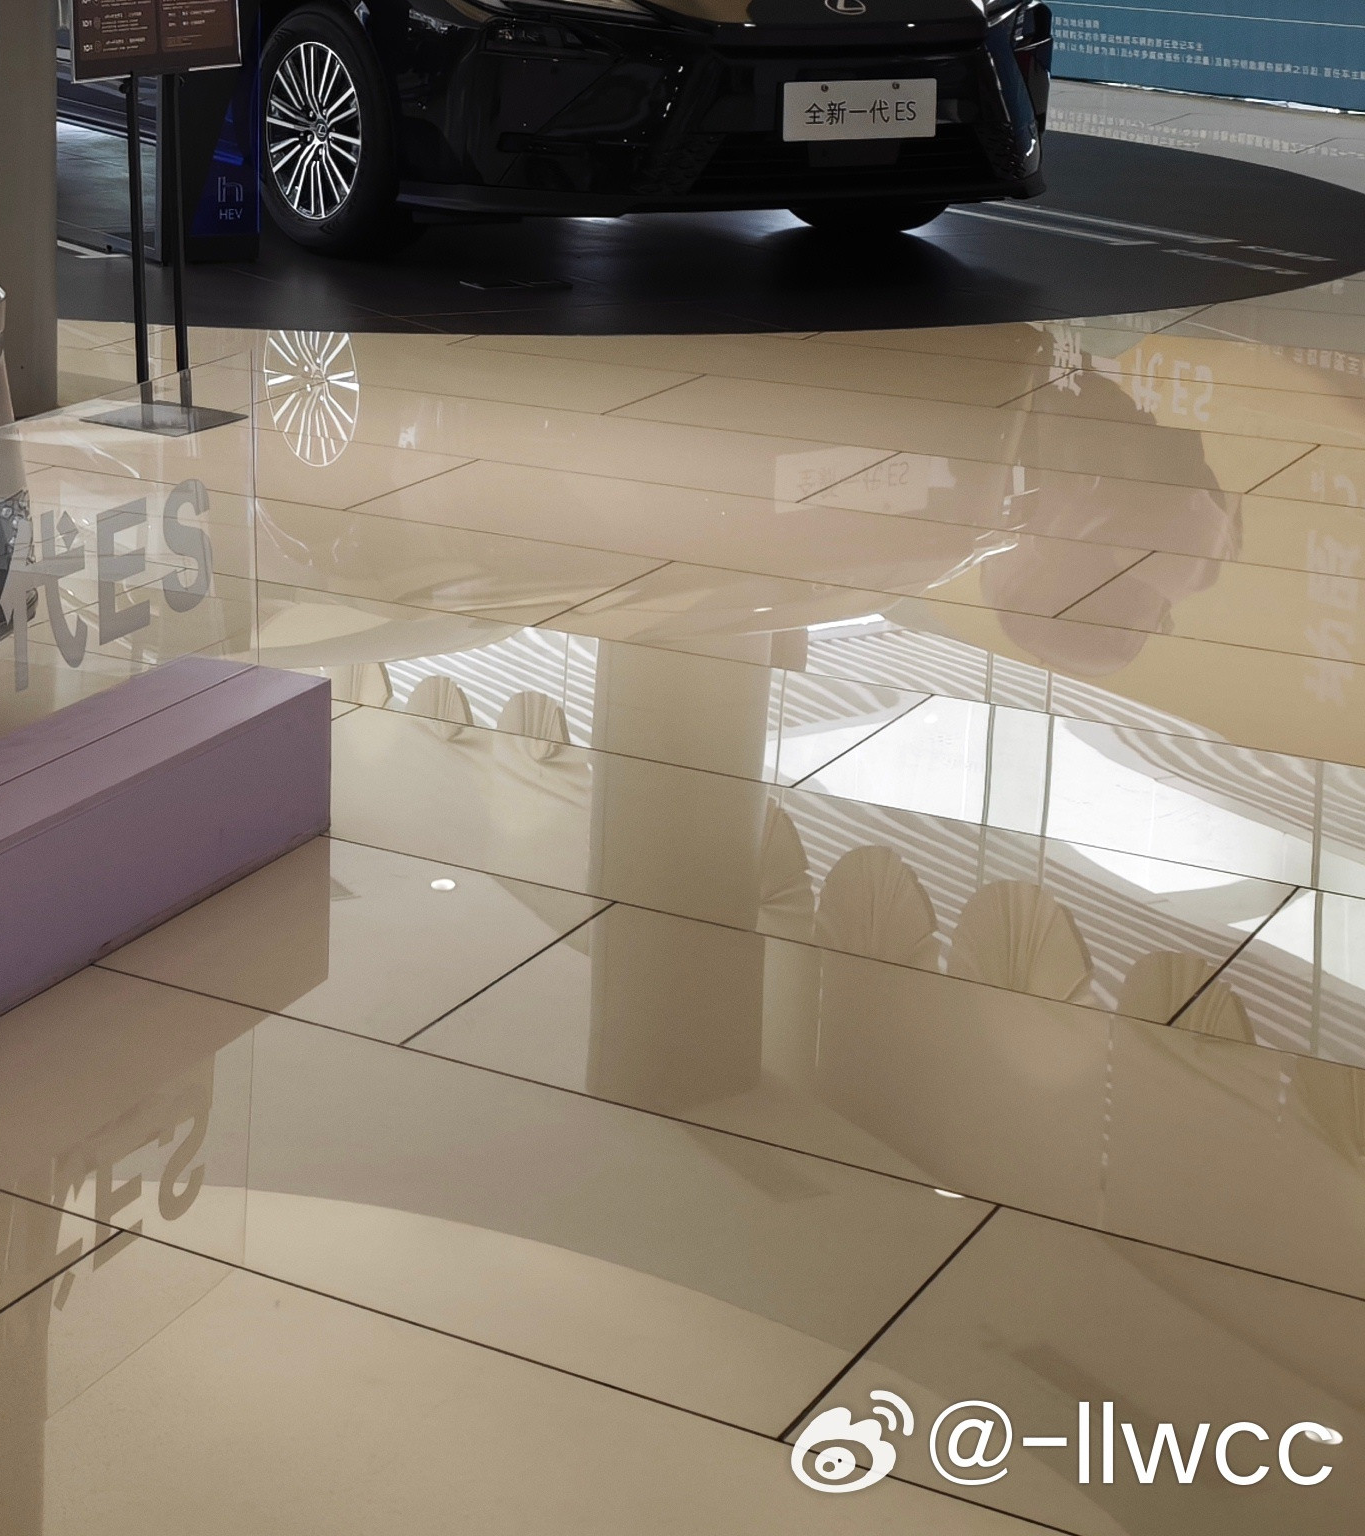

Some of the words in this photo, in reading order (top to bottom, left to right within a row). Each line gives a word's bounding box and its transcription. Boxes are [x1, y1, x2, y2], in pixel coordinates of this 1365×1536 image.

[804, 99, 917, 127] 全新一代ES
[218, 208, 244, 221] HEV
